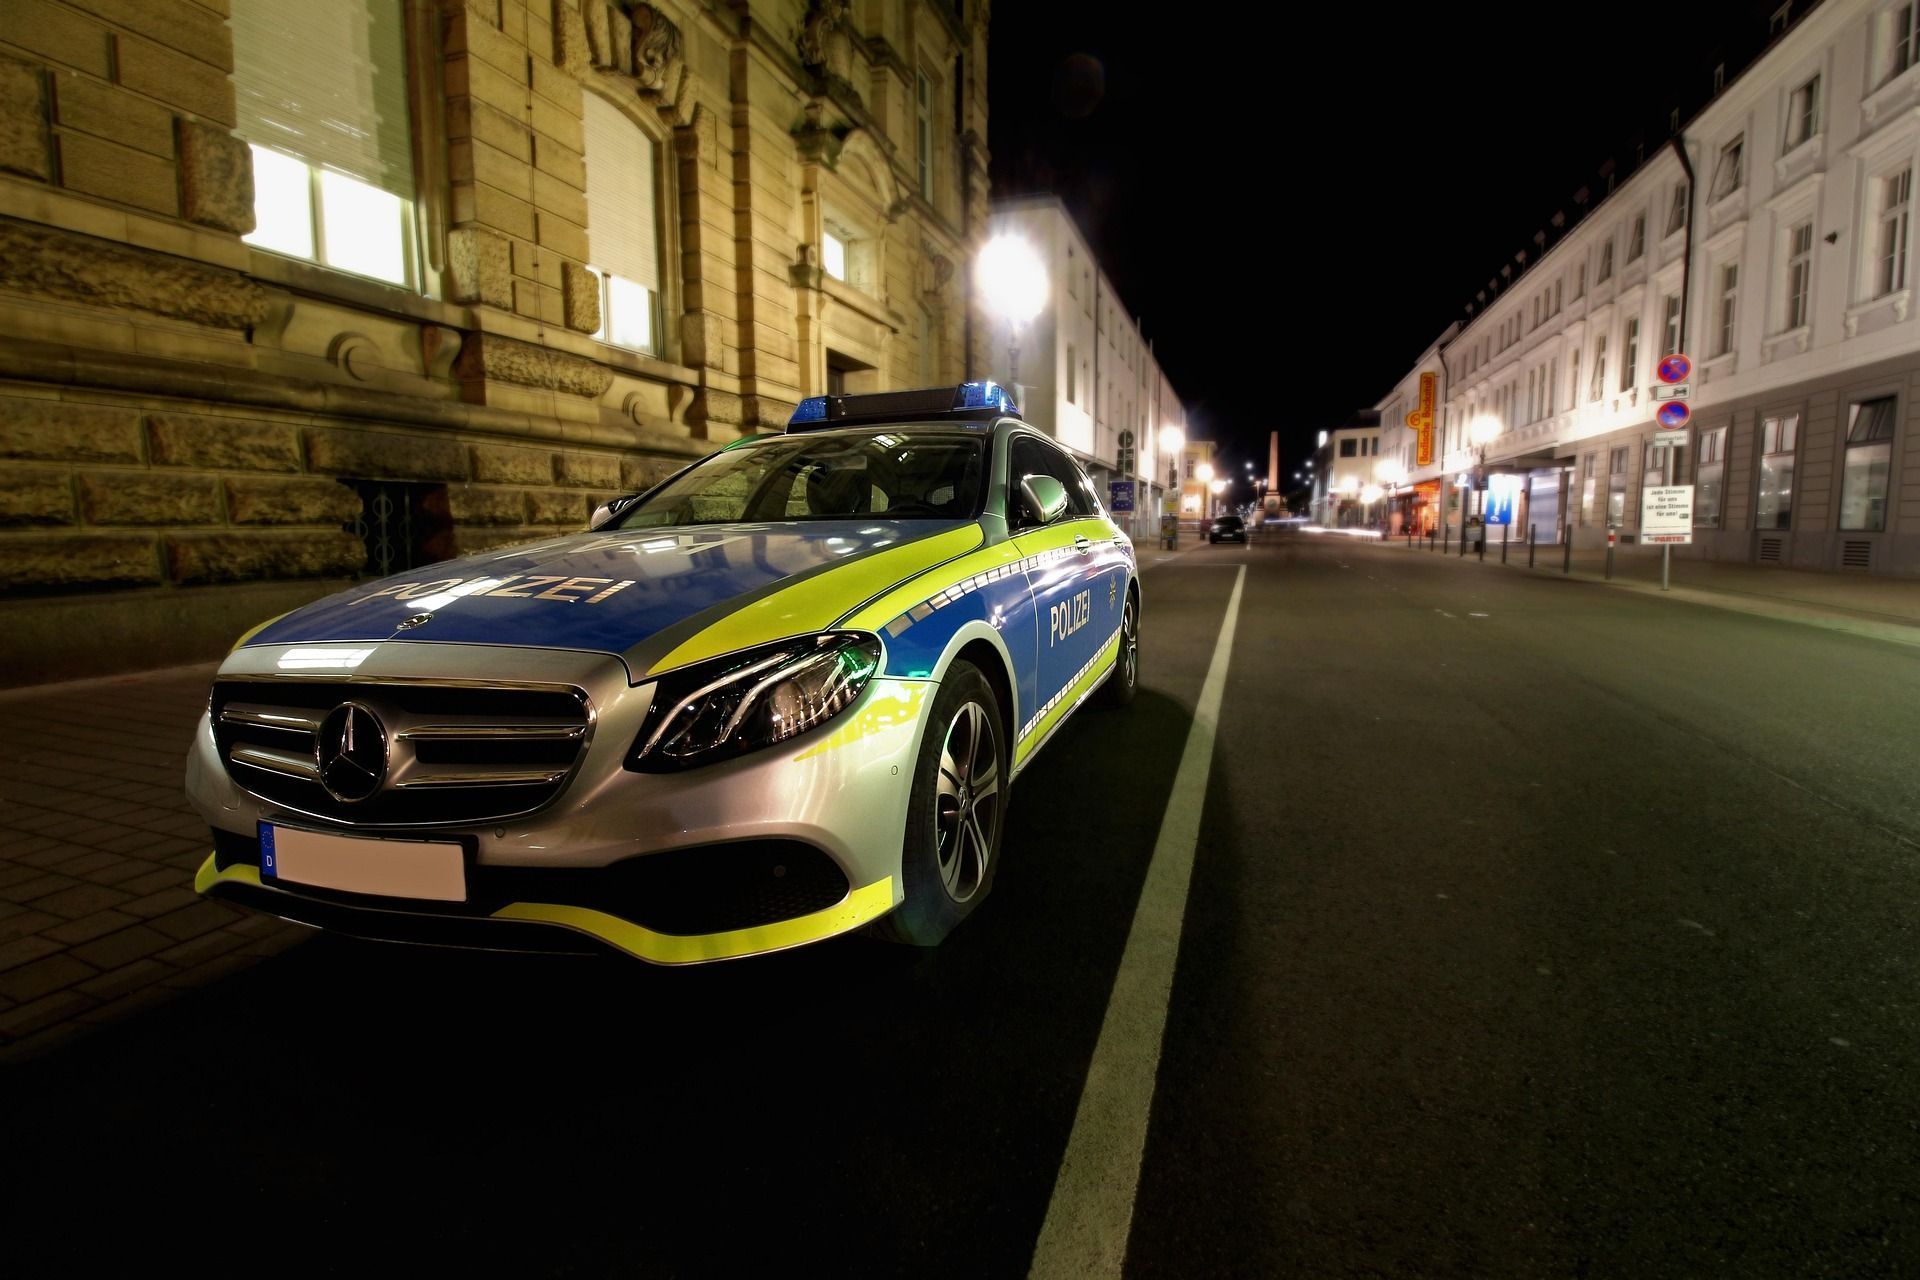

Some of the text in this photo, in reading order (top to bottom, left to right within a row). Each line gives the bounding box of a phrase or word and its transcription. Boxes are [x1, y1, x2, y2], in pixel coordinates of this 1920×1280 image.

[1420, 423, 1430, 462] Badische
[1050, 588, 1090, 648] POLIZEI
[266, 855, 273, 867] D
